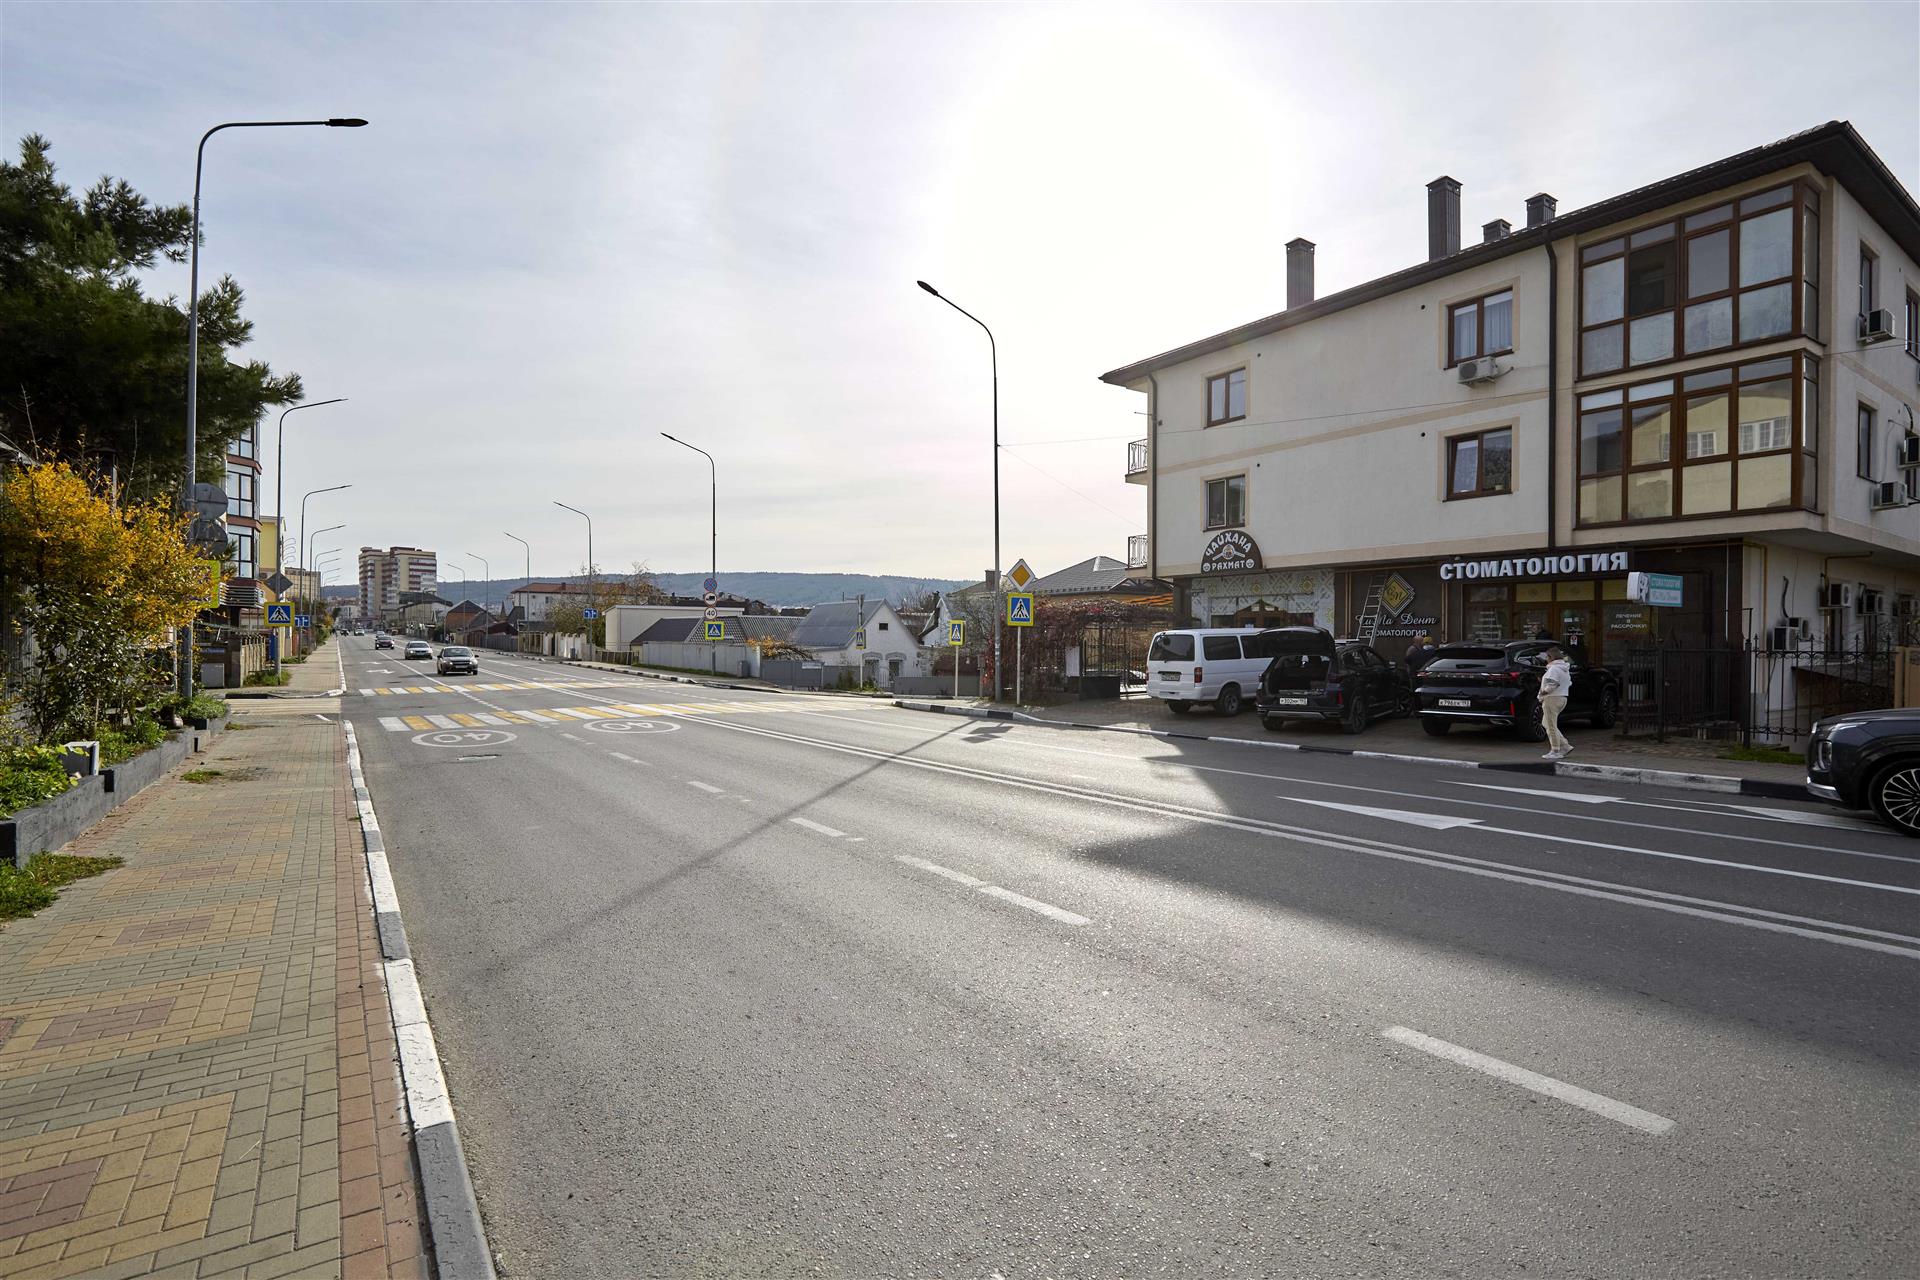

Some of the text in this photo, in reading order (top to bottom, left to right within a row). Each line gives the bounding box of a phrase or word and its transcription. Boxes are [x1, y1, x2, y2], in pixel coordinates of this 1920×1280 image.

[1211, 560, 1245, 571] РАХМАТ
[1440, 552, 1628, 580] СТОМАТОЛОГИЯ
[601, 721, 654, 731] 40
[433, 732, 492, 743] 40
